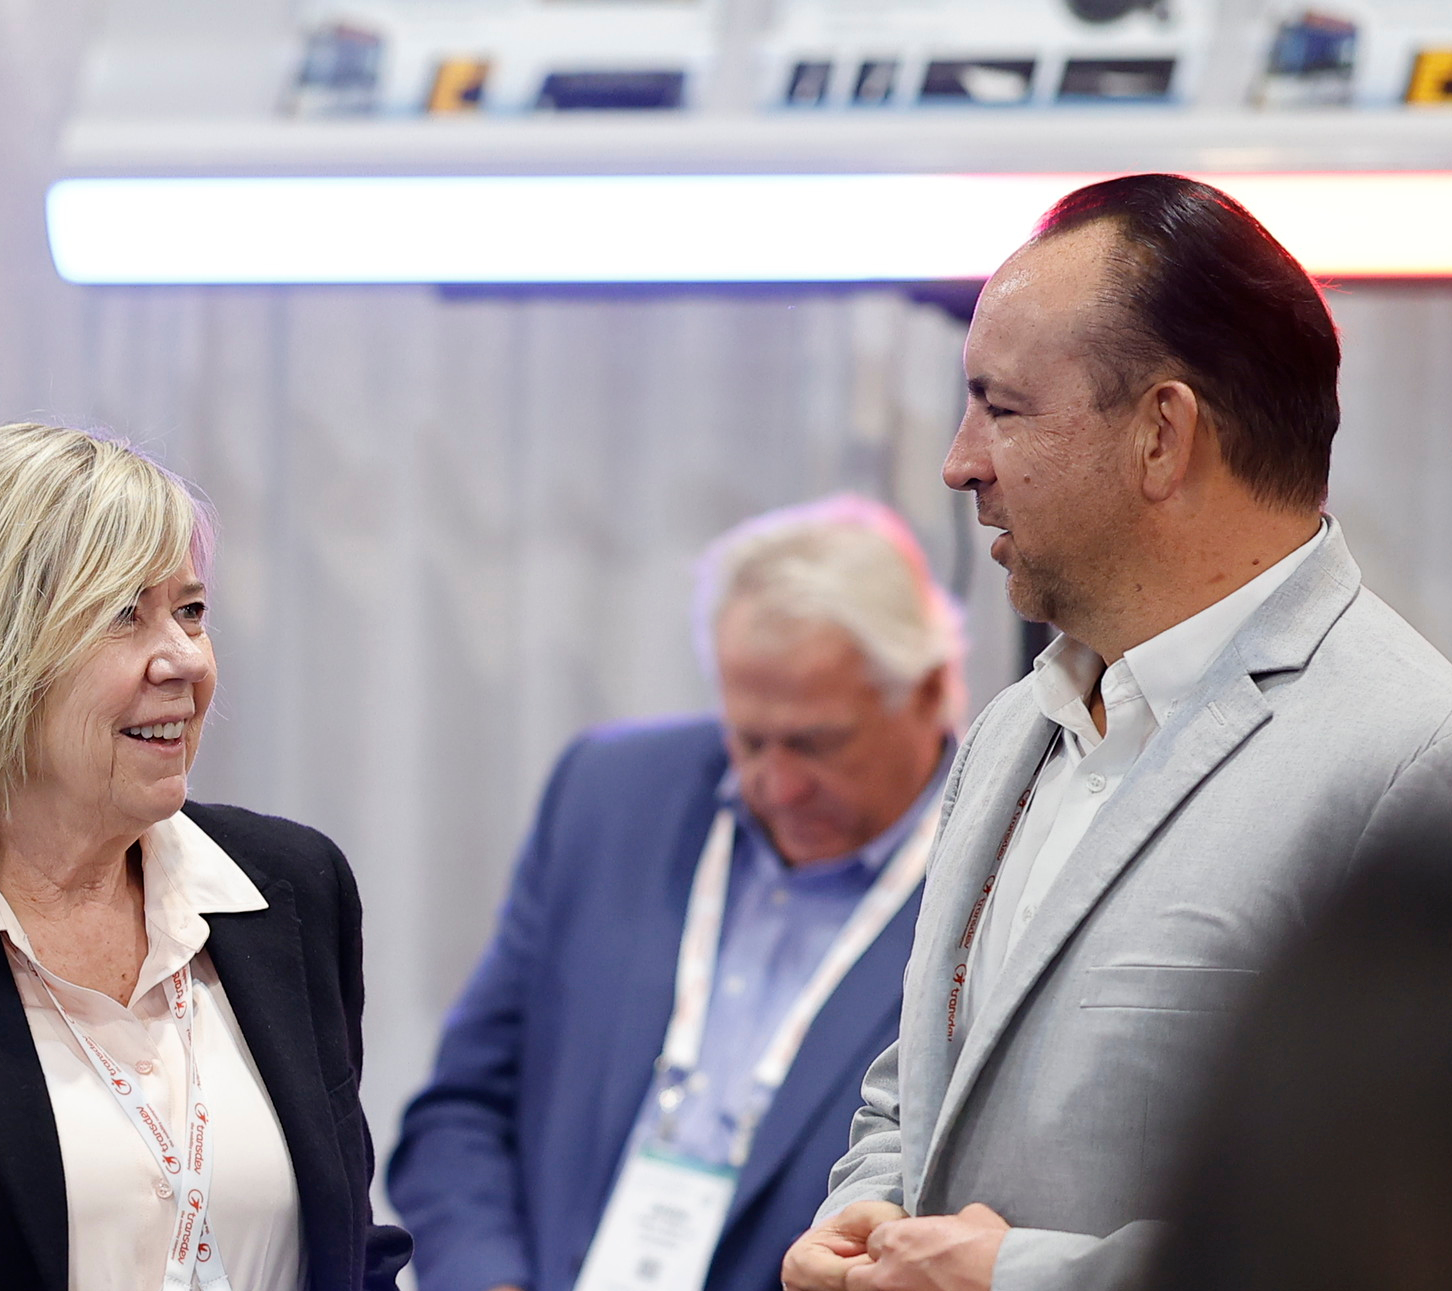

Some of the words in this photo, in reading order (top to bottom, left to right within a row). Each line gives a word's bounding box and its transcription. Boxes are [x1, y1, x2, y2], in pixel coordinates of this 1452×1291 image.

[83, 1035, 117, 1076] transdev
[136, 1107, 169, 1152] transdev
[194, 1125, 205, 1175] transdev
[178, 1212, 196, 1265] transdev
